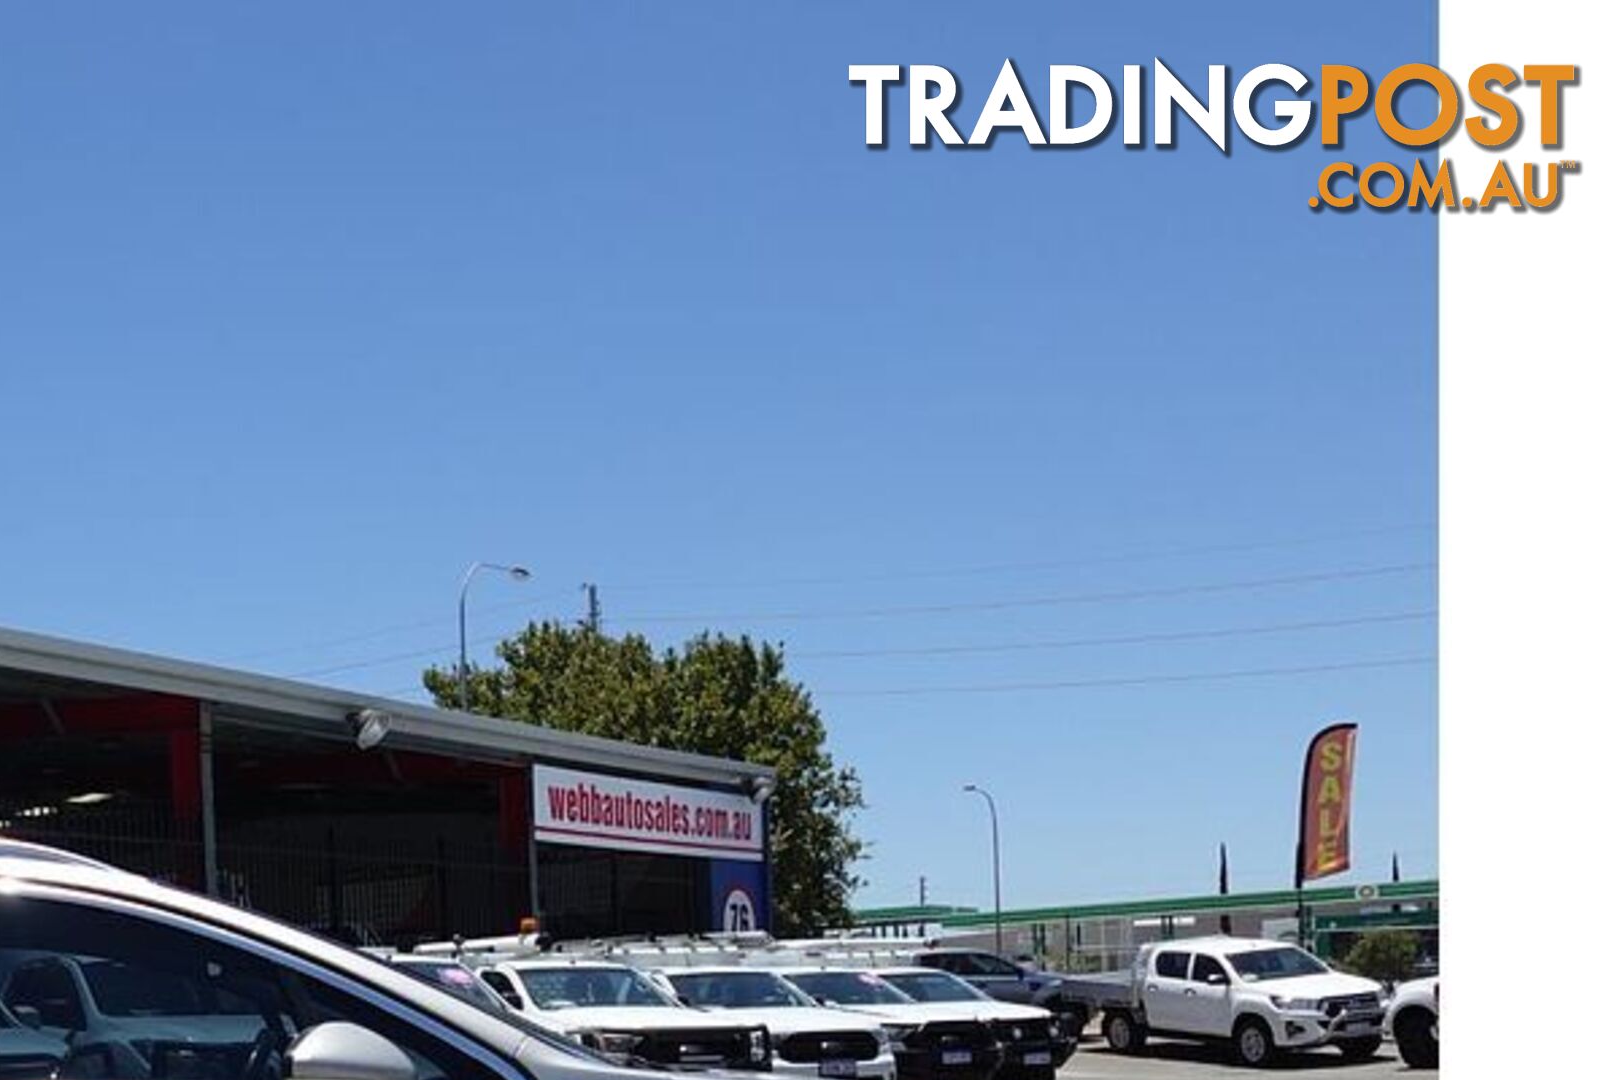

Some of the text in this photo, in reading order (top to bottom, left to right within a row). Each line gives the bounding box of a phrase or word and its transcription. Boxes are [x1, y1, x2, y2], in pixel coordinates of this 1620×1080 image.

[547, 783, 752, 841] webbautosales.com.au
[1317, 740, 1344, 869] SALE
[730, 903, 750, 931] 76
